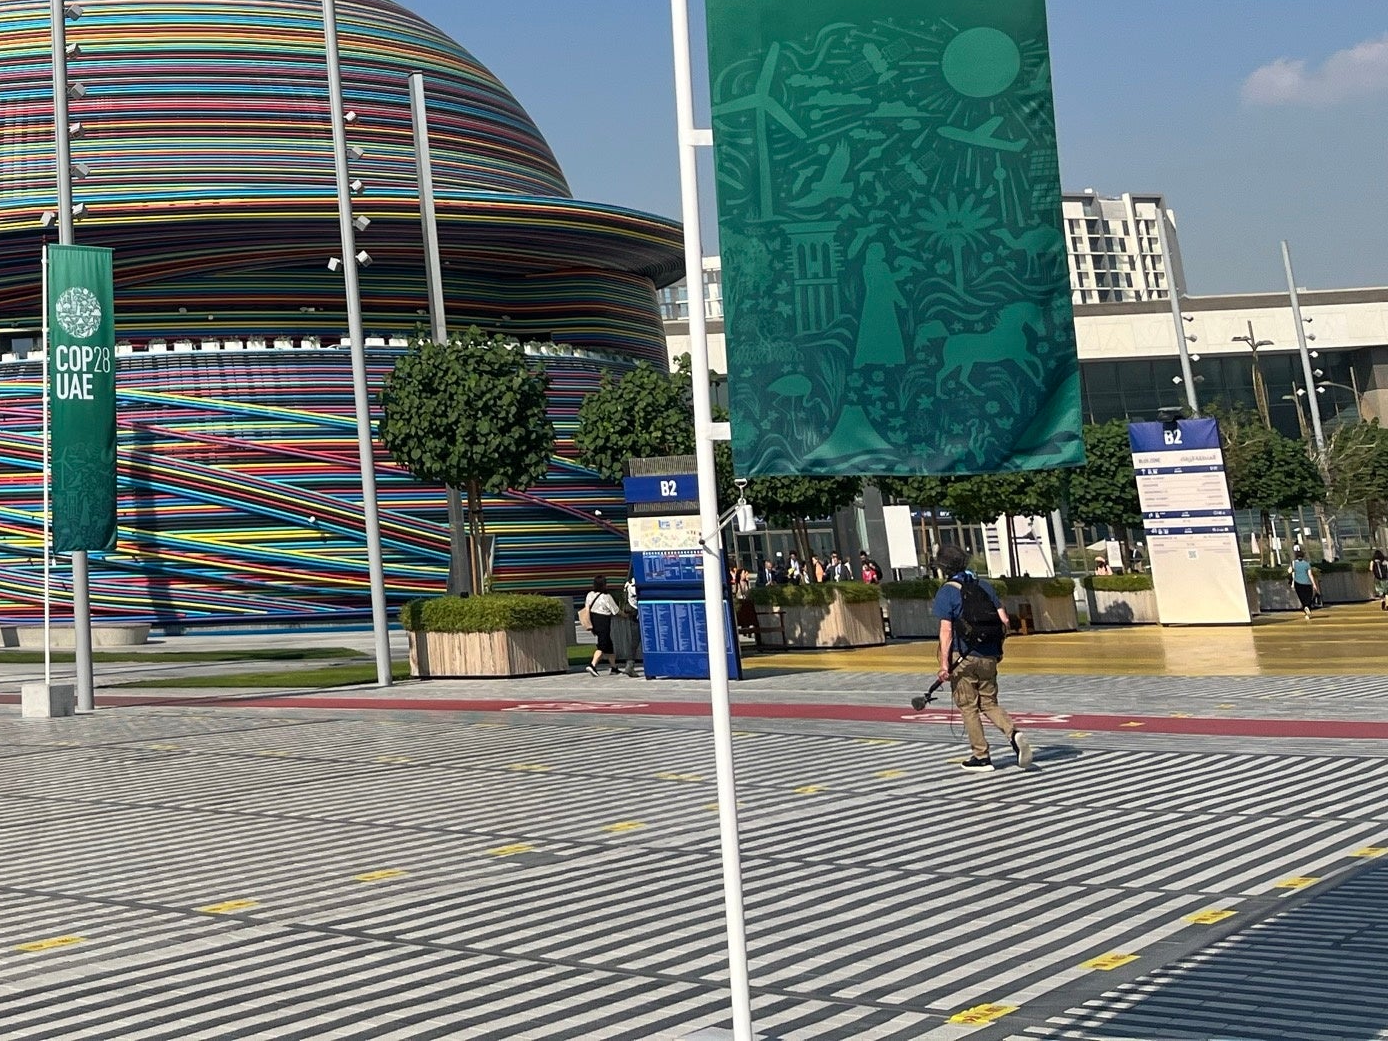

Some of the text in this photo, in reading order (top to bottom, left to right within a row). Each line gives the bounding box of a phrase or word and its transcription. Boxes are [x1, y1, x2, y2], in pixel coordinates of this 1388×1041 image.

[56, 345, 110, 373] COP28
[56, 373, 94, 400] UAE
[1164, 428, 1183, 445] B2
[660, 480, 678, 496] B2
